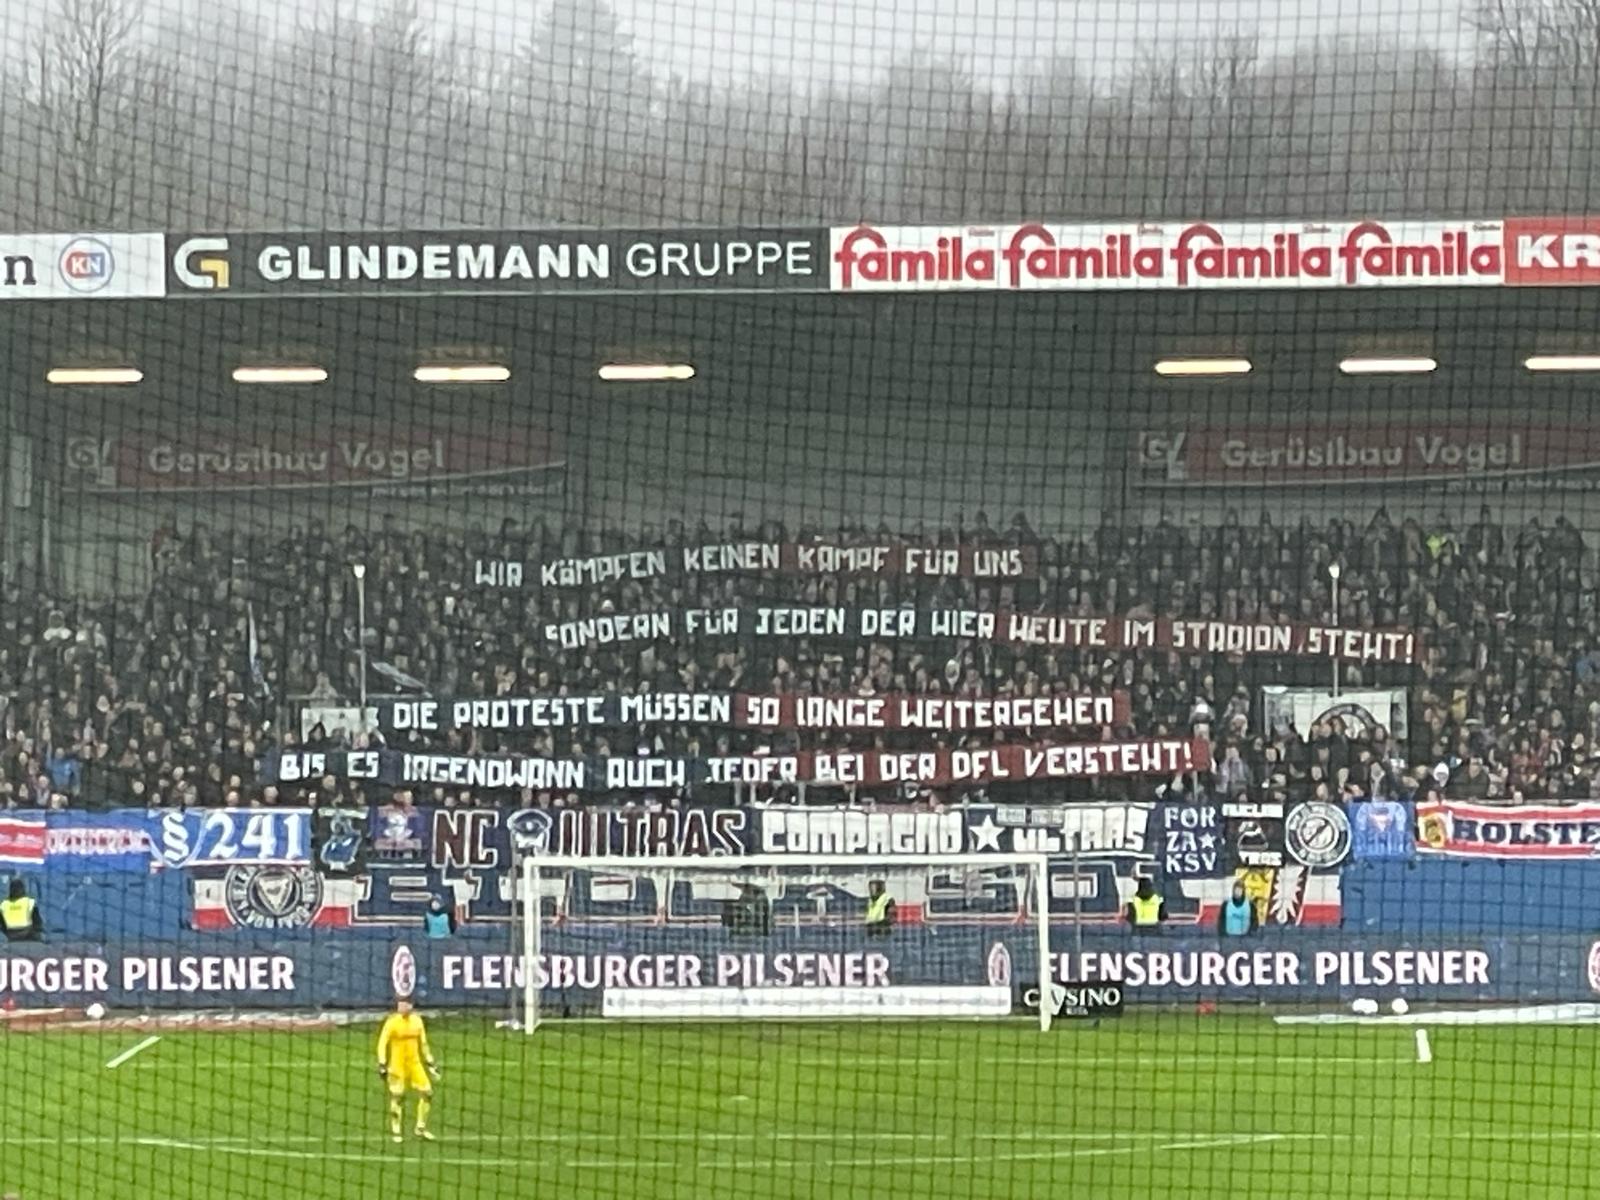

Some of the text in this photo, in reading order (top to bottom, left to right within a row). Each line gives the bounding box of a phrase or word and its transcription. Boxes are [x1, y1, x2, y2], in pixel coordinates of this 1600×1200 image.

[70, 255, 102, 276] KN
[258, 240, 812, 281] GLINDEMANN GRUPPE
[834, 222, 1500, 288] famila famila famila famila
[338, 439, 444, 476] Vogel
[1414, 433, 1522, 474] Vogel
[475, 559, 523, 587] WIR
[541, 551, 666, 587] KÄMPFEN
[684, 543, 780, 572] KEINEN
[798, 545, 890, 572] KAMPF
[973, 550, 1023, 577] UNS
[686, 608, 739, 635] FÜR
[756, 608, 845, 635] JEDEN
[861, 608, 915, 637] DER
[931, 610, 996, 639] HIER
[1008, 614, 1107, 647] HEUTE
[1124, 620, 1155, 647] IM
[1172, 621, 1292, 653] STADION
[1307, 627, 1414, 664] STEHT!
[393, 702, 438, 730] DIE
[454, 697, 605, 728] PROTESTE
[621, 693, 730, 723] MÜSSEN
[747, 697, 780, 725] SO
[900, 697, 1114, 728] WEITERGEHEN
[279, 753, 326, 781] BIS
[347, 751, 379, 778] ES
[403, 753, 584, 790] IRGENDWANN
[606, 758, 685, 788] AUCH
[815, 753, 864, 782] BEI
[880, 754, 936, 781] DER
[952, 750, 1009, 778] DFL
[1024, 741, 1192, 777] VERSTEHT!
[202, 812, 304, 860] 241
[1013, 806, 1150, 852] ULTRAS
[1164, 805, 1216, 828] FOR
[431, 808, 499, 868] NC
[1164, 830, 1196, 852] ZA
[1165, 850, 1217, 874] KSV
[122, 956, 294, 992] PILSENER
[442, 953, 890, 990] FLENSBURGER PILSENER
[1315, 951, 1489, 986] PILSENER
